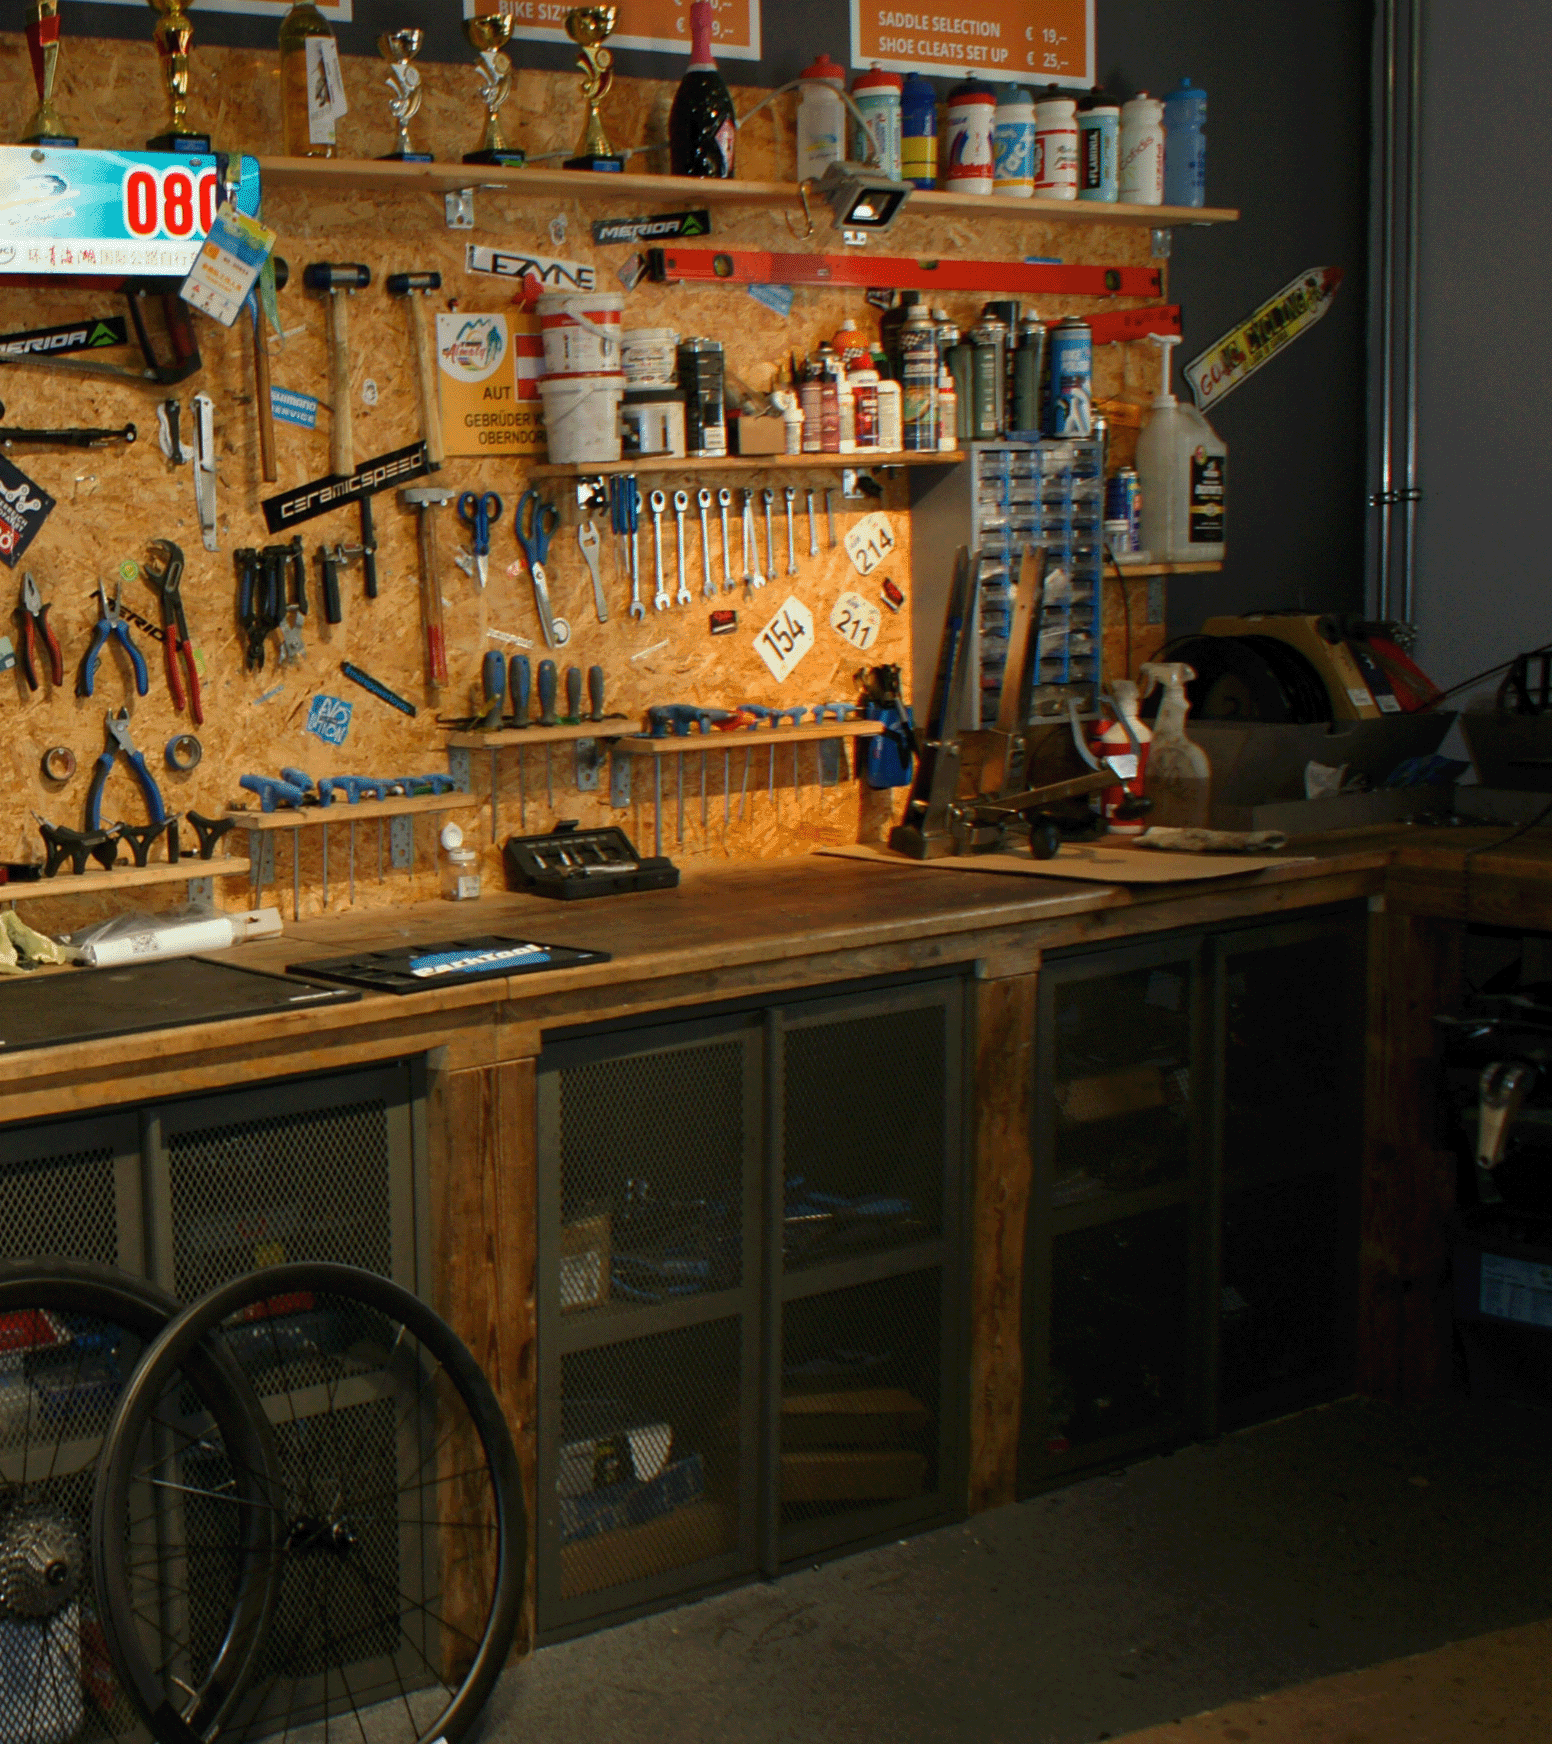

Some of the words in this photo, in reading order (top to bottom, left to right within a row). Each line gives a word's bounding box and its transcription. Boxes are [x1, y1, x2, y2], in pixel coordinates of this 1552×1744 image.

[499, 1, 534, 19] BIKE
[676, 17, 685, 33] €
[878, 11, 929, 30] SADDLE
[932, 16, 1000, 37] SELECTION
[1025, 27, 1034, 41] €
[879, 36, 914, 53] SHOE
[917, 40, 964, 58] CLEATS
[967, 45, 989, 61] SET
[991, 48, 1009, 63] UP
[1026, 51, 1035, 66] €
[127, 171, 218, 235] 080
[598, 220, 681, 240] MERIDA
[467, 244, 596, 291] LEZYNE
[482, 386, 512, 401] AUT
[464, 410, 530, 428] GEBRÜDER
[478, 430, 547, 445] OBERNDOR
[855, 528, 893, 572] 214
[763, 610, 805, 661] 154
[836, 609, 871, 647] 211
